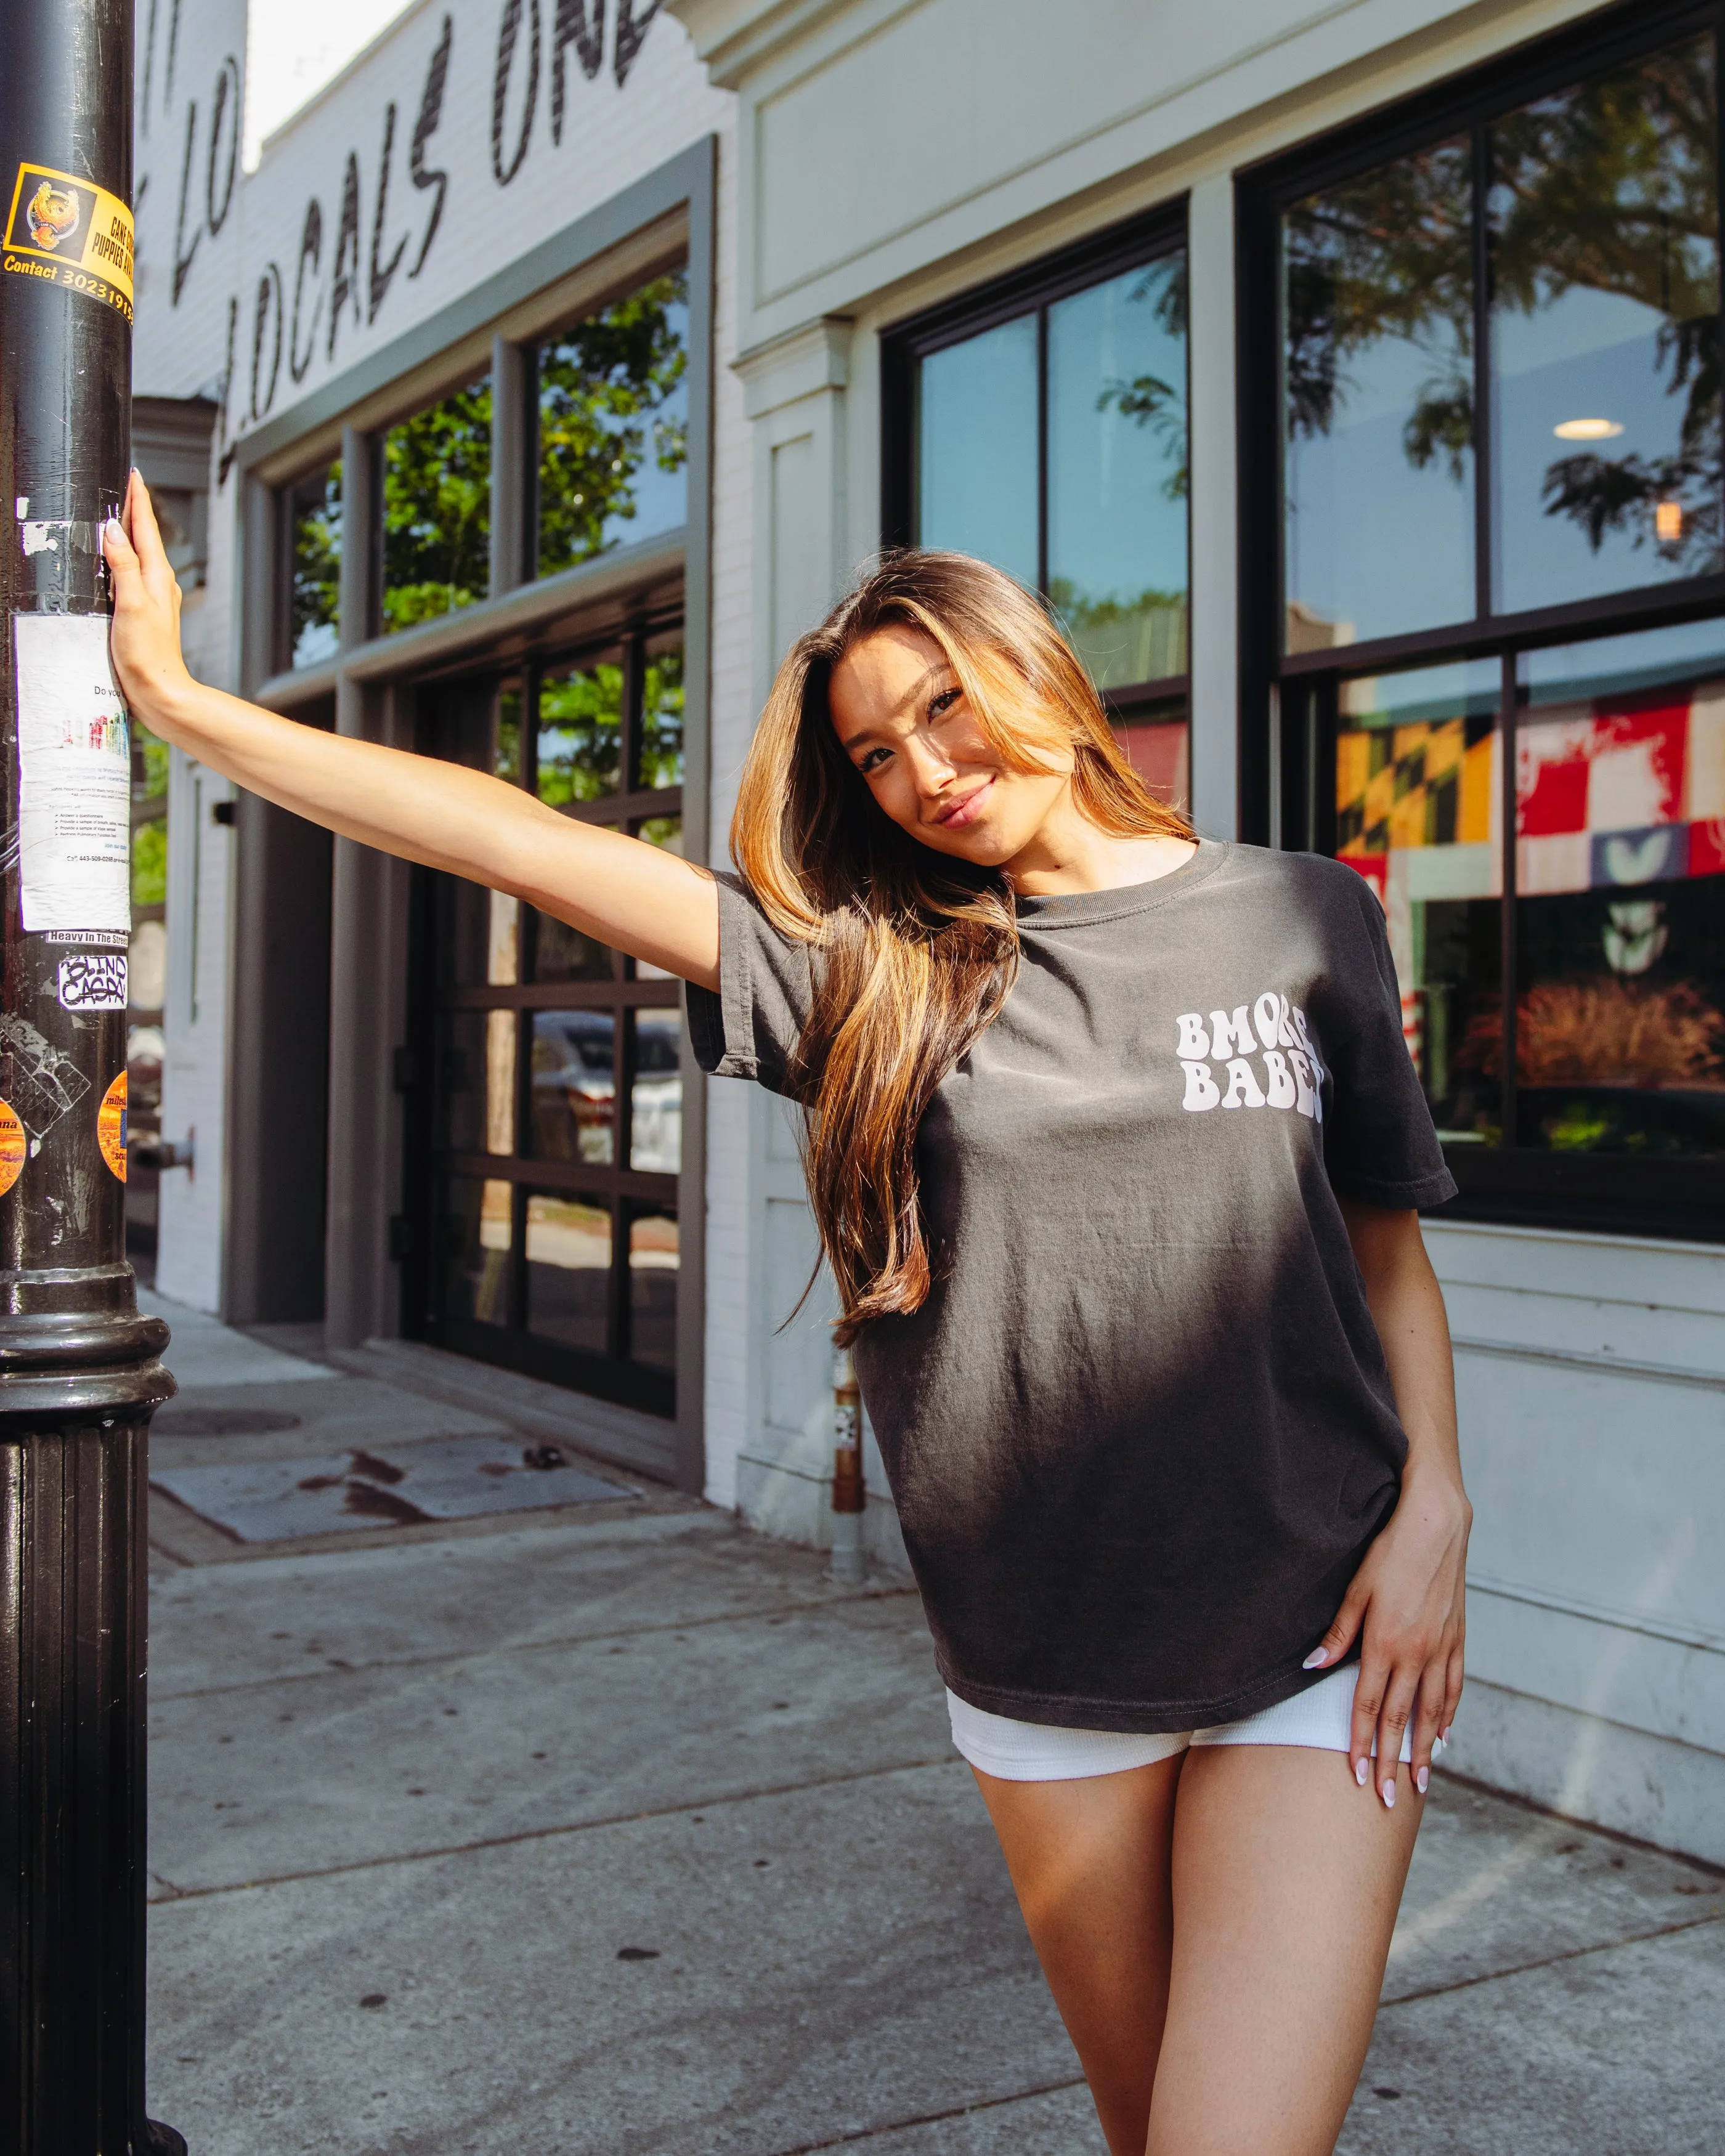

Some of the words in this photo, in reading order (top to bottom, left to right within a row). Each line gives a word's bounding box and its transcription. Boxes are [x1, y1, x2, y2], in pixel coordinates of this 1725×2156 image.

[111, 216, 127, 246] CANE
[92, 232, 123, 269] PUPPIES
[217, 14, 453, 487] LOCALS
[4, 254, 58, 279] Contact
[94, 686, 106, 695] Do
[108, 689, 121, 698] you
[51, 931, 83, 941] Heavy
[85, 933, 94, 941] In
[97, 933, 111, 943] The
[1175, 992, 1320, 1066] BMORE
